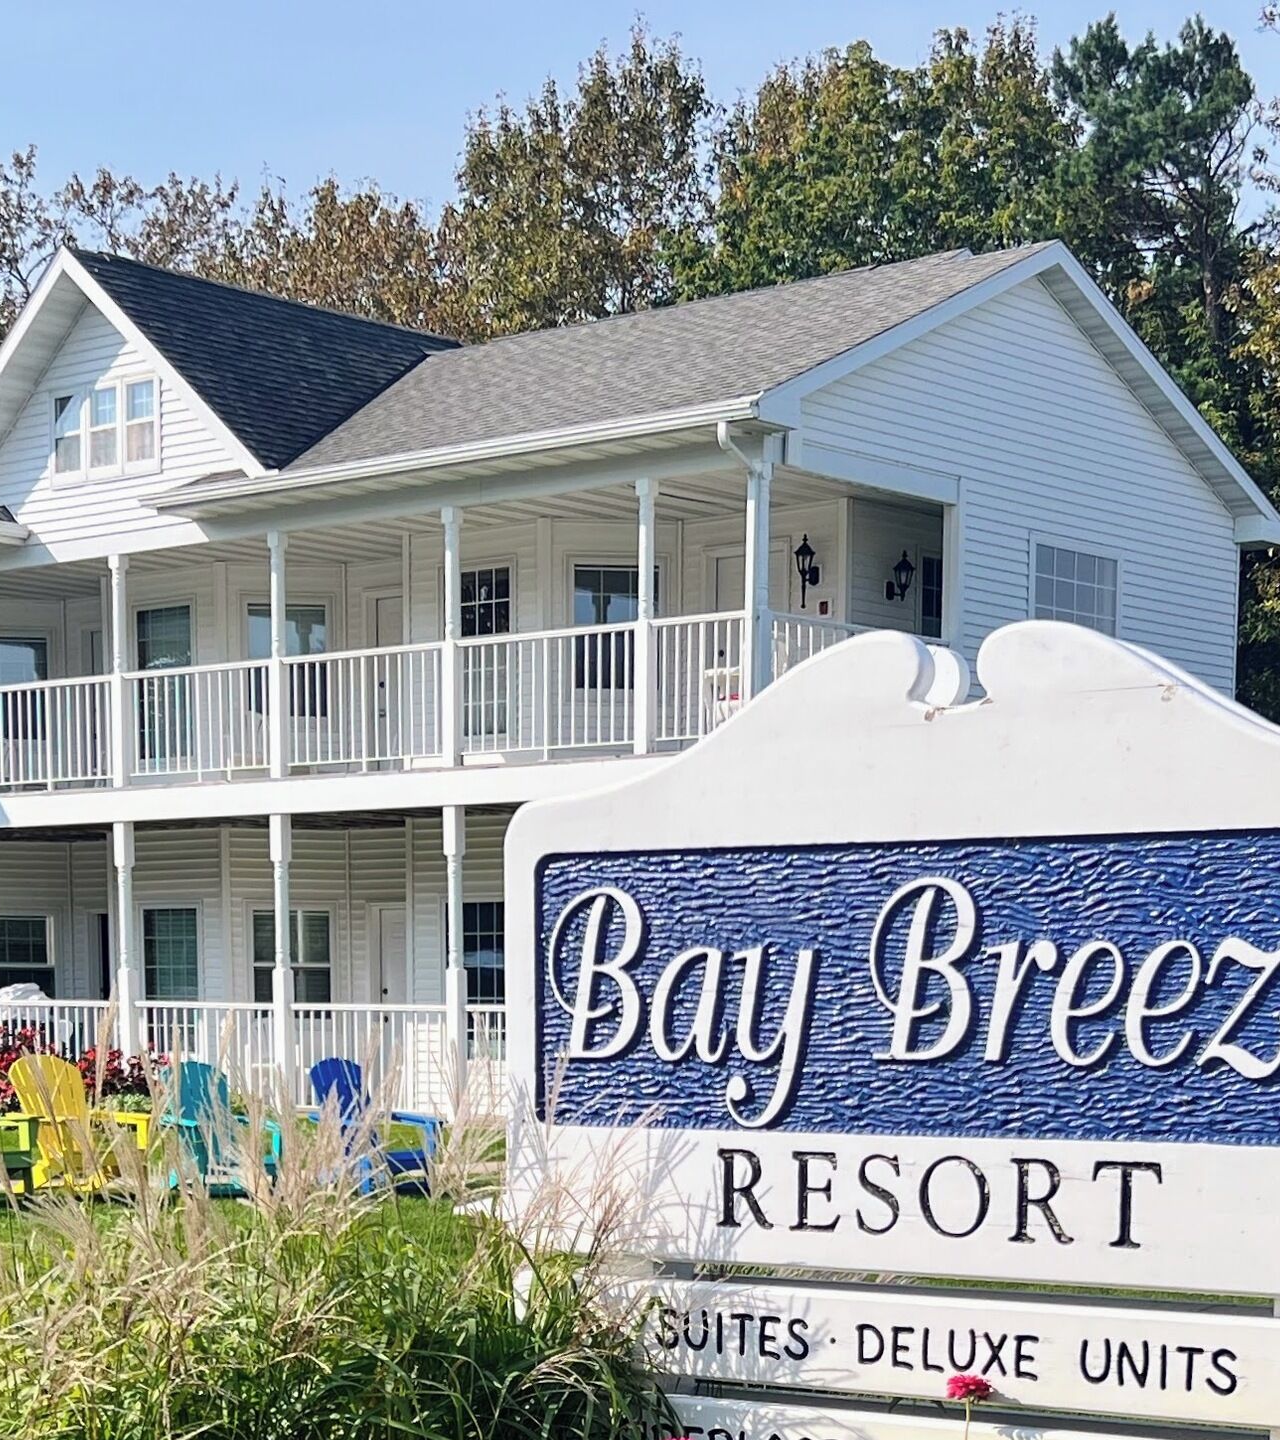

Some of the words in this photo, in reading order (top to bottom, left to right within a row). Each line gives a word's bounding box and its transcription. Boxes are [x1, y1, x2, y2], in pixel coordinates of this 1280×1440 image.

[547, 885, 816, 1129] Bay
[717, 1147, 1163, 1249] RESORT
[655, 1308, 810, 1361] SUITES
[855, 1323, 1040, 1381] DELUXE
[1080, 1337, 1238, 1396] UNITS
